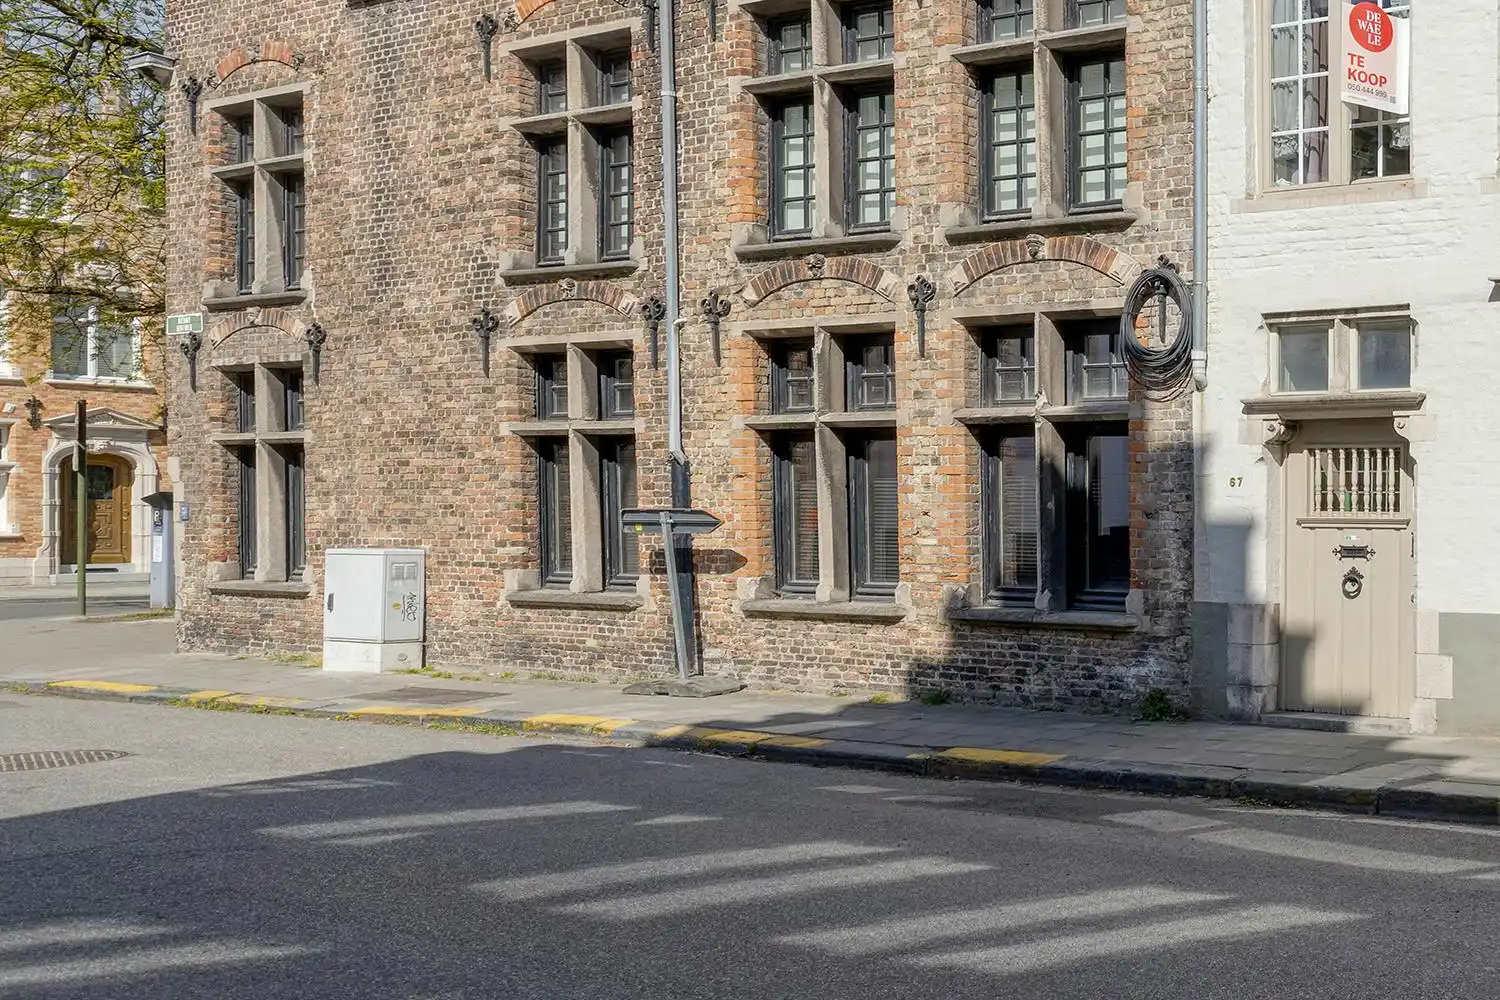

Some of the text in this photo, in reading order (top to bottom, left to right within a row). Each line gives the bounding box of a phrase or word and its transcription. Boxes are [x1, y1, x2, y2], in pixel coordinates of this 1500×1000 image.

[1366, 10, 1381, 24] DE
[1357, 18, 1381, 35] WAE
[1367, 33, 1381, 46] LE
[1347, 53, 1365, 67] TE
[1347, 67, 1387, 87] KOOP
[1229, 477, 1243, 488] 67
